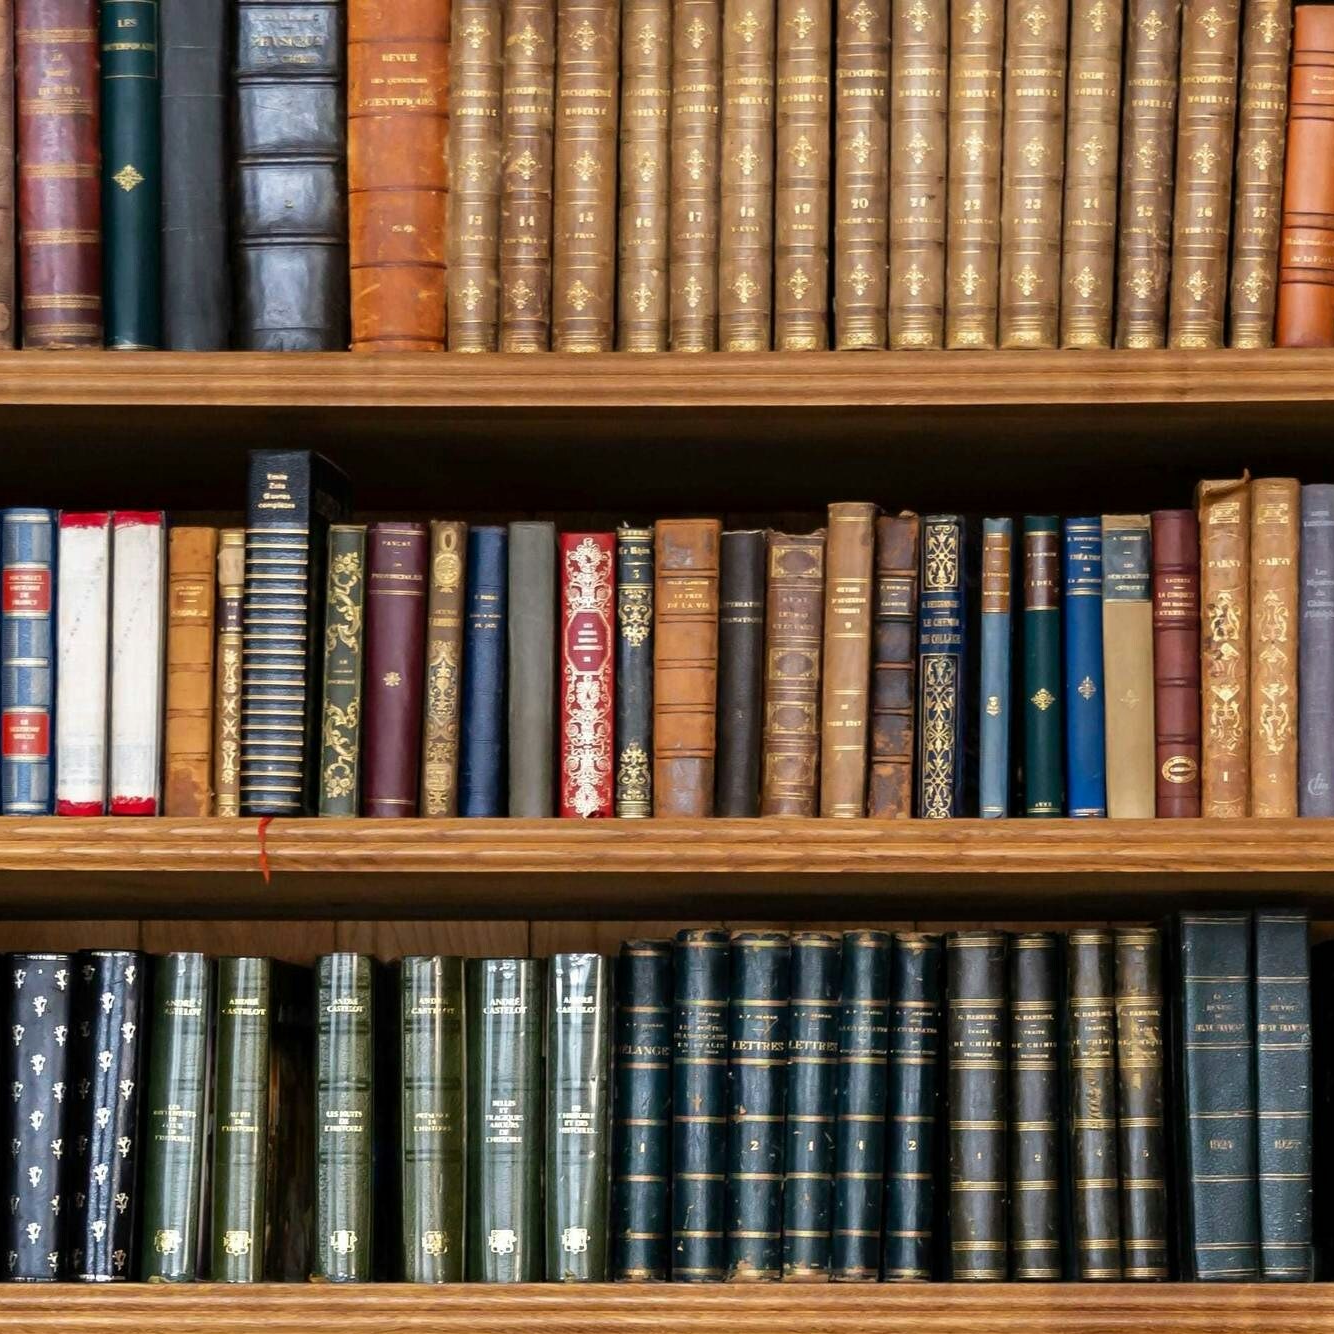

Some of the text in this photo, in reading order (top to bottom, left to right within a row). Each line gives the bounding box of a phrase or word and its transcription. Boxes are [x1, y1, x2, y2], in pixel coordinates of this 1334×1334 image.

[117, 20, 137, 28] LES
[382, 53, 418, 62] REVUE
[851, 198, 868, 209] 20
[964, 200, 980, 211] 22
[1253, 207, 1268, 218] 27
[1208, 560, 1241, 568] PARNY
[490, 997, 520, 1005] ANDRÉ
[484, 1006, 527, 1014] CASTELOT
[732, 1041, 784, 1051] LETTRES
[750, 1141, 759, 1151] 2
